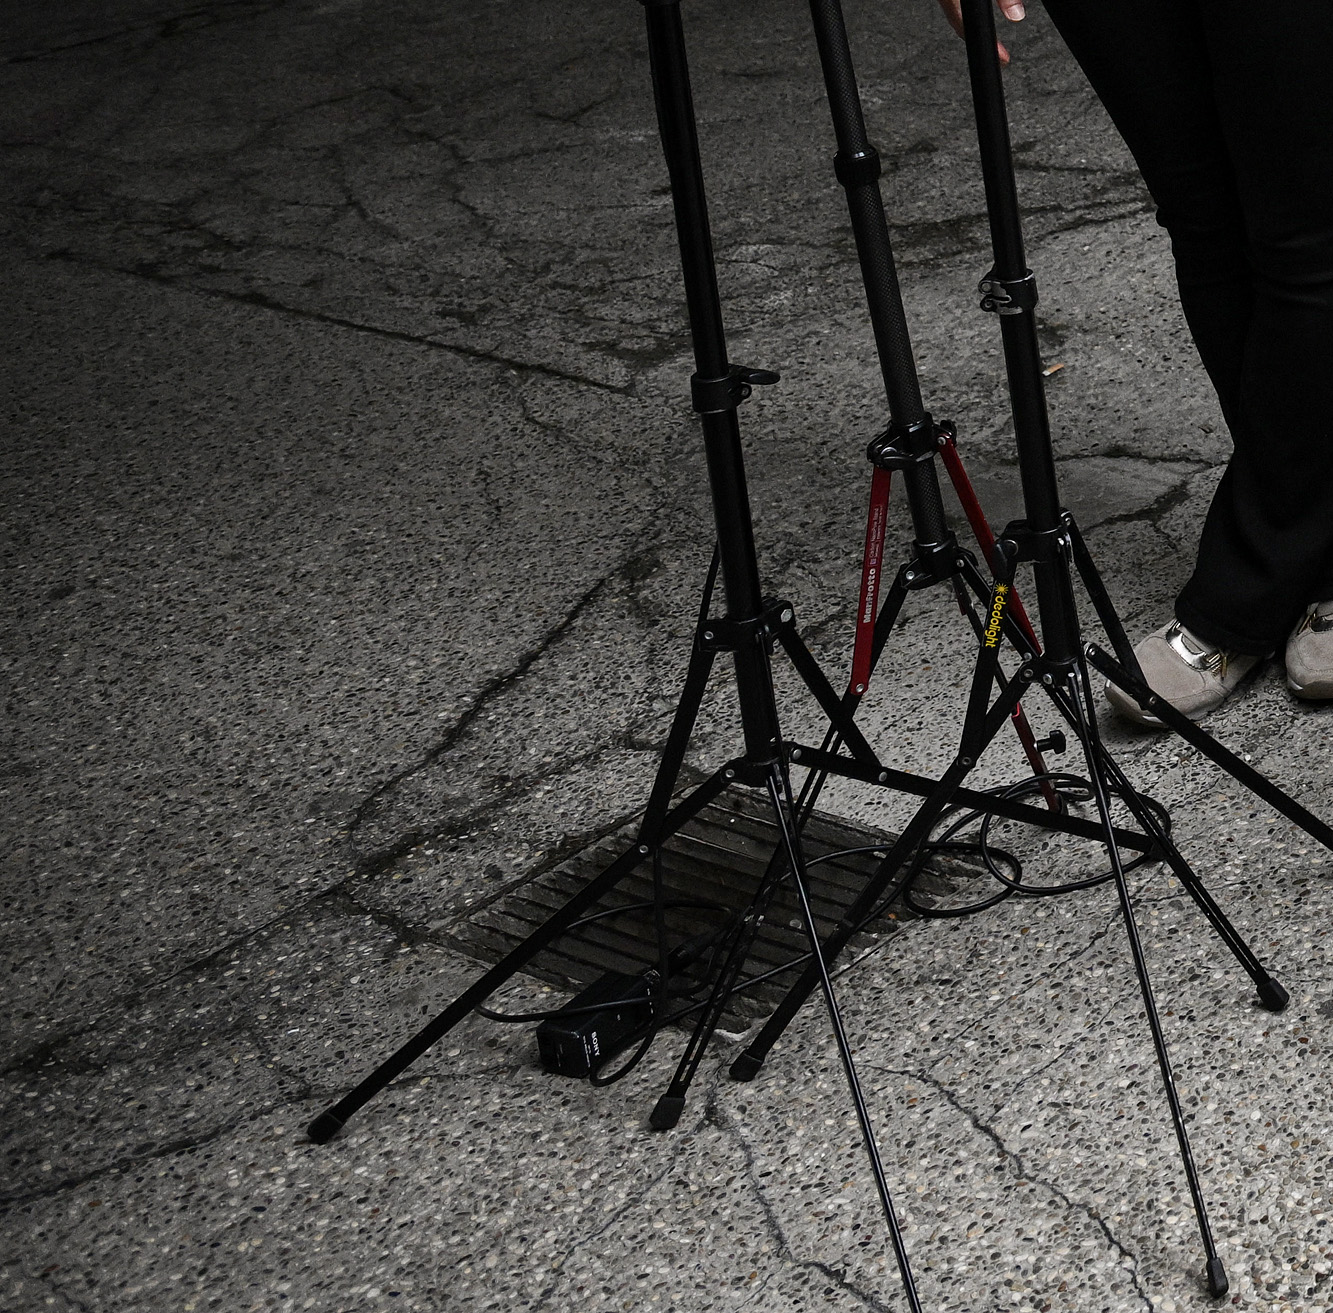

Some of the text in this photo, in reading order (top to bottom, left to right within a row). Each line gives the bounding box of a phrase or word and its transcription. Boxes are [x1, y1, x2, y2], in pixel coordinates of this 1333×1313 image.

[863, 568, 877, 624] Manfrotto
[984, 595, 1006, 648] dedolight
[591, 1031, 601, 1057] SONY
